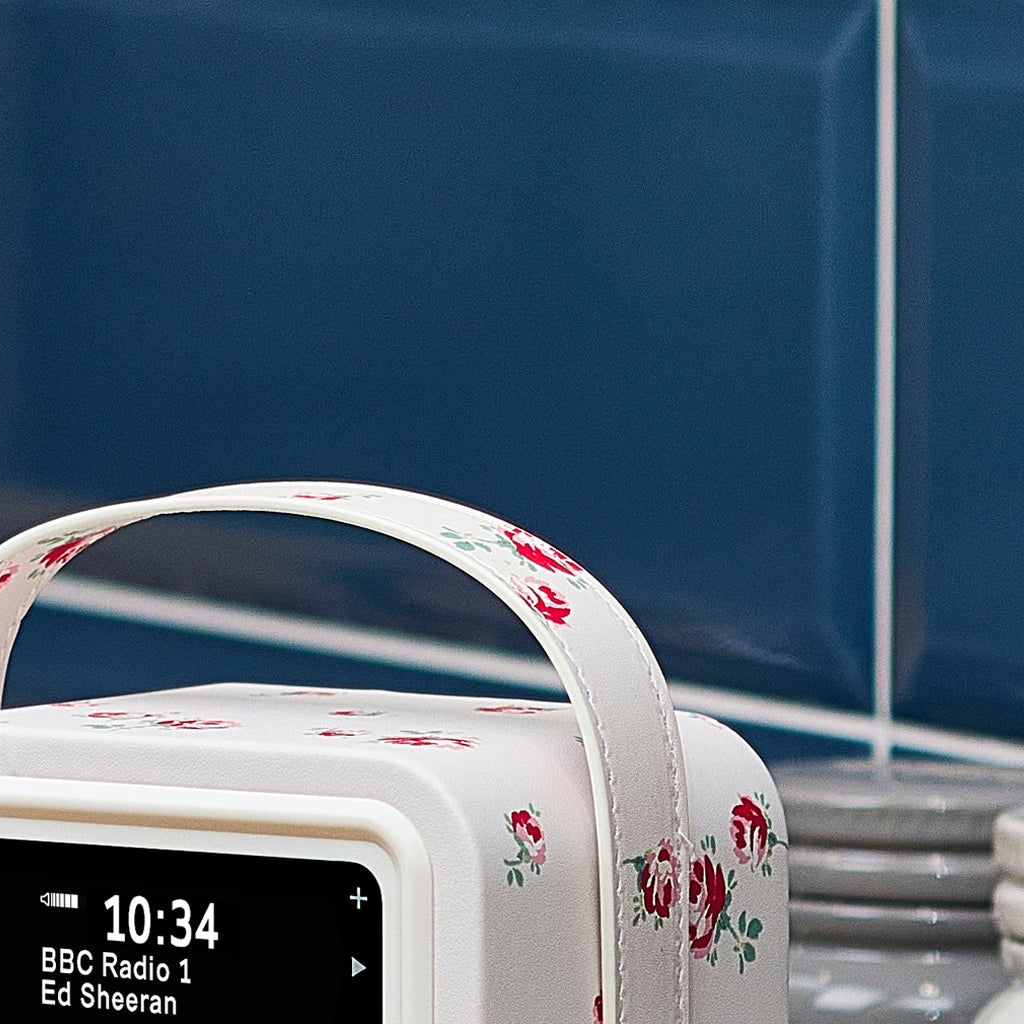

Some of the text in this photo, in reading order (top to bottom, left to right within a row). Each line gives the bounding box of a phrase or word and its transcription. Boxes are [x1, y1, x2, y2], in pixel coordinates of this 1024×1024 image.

[104, 894, 219, 950] 10:34
[41, 946, 192, 984] BBC Radio 1
[41, 978, 178, 1015] Ed Sheeran
